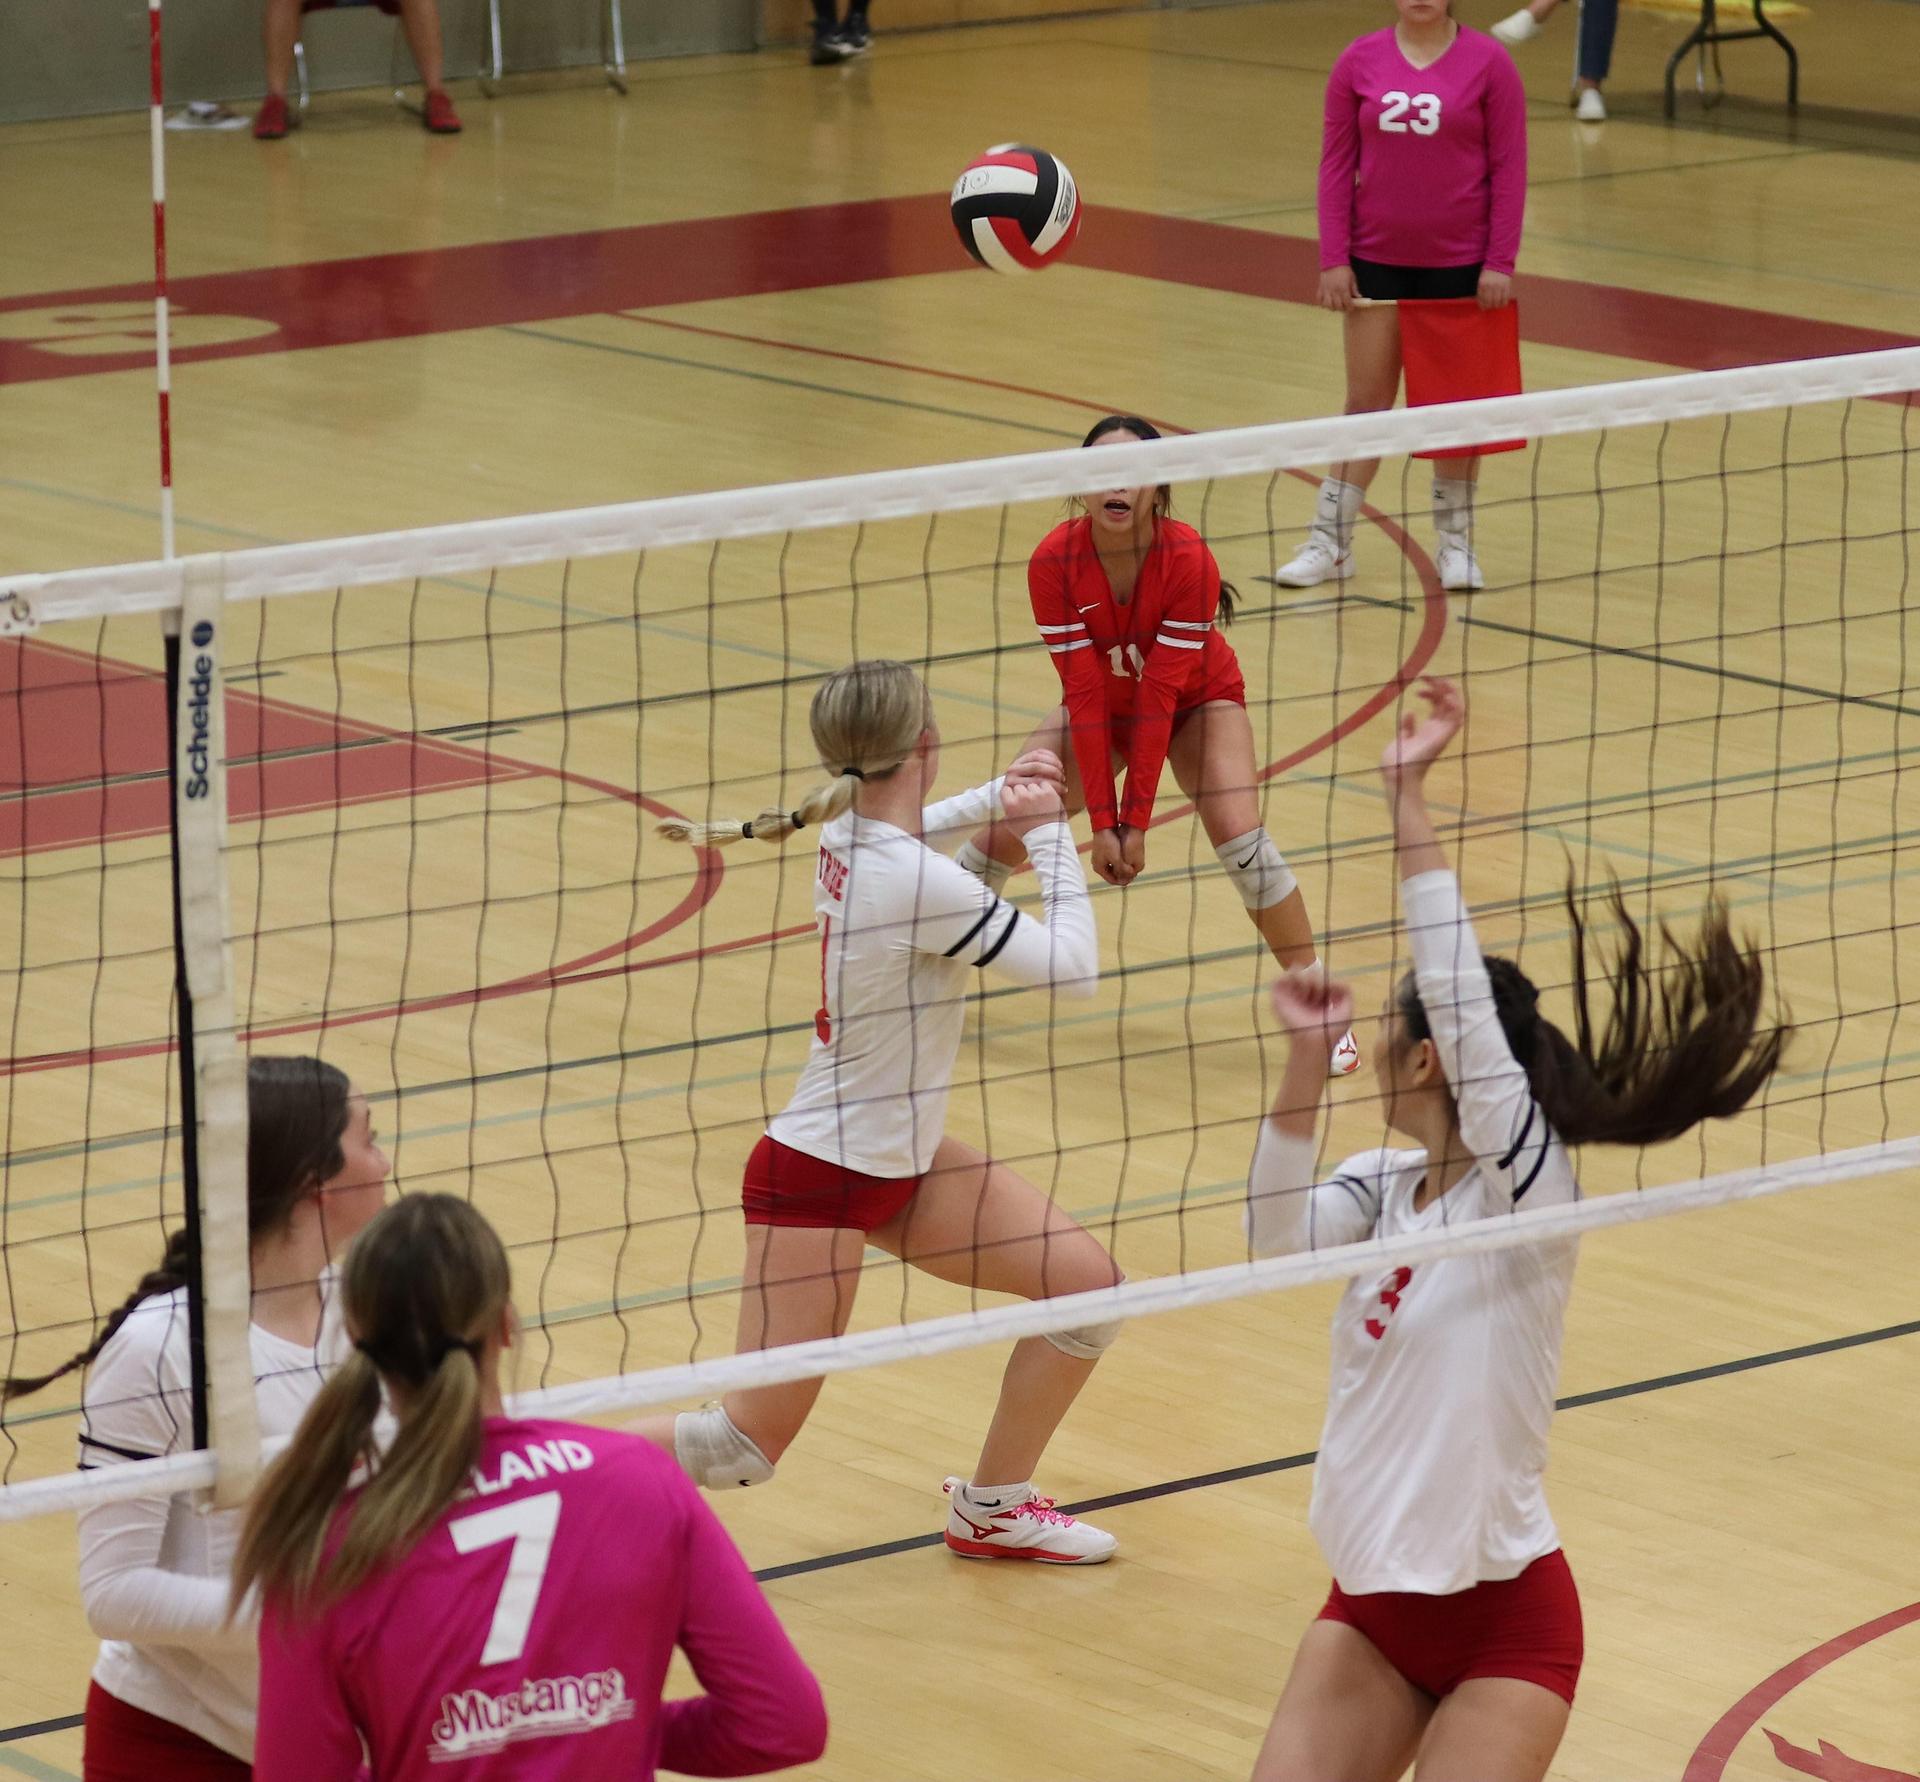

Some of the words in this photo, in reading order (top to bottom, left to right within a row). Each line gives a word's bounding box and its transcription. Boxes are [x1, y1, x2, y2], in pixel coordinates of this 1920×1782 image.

[1379, 90, 1442, 136] 23
[186, 655, 213, 799] Schelde
[456, 1440, 595, 1499] LAND
[448, 1490, 562, 1667] 7
[430, 1668, 627, 1751] Mustangs
